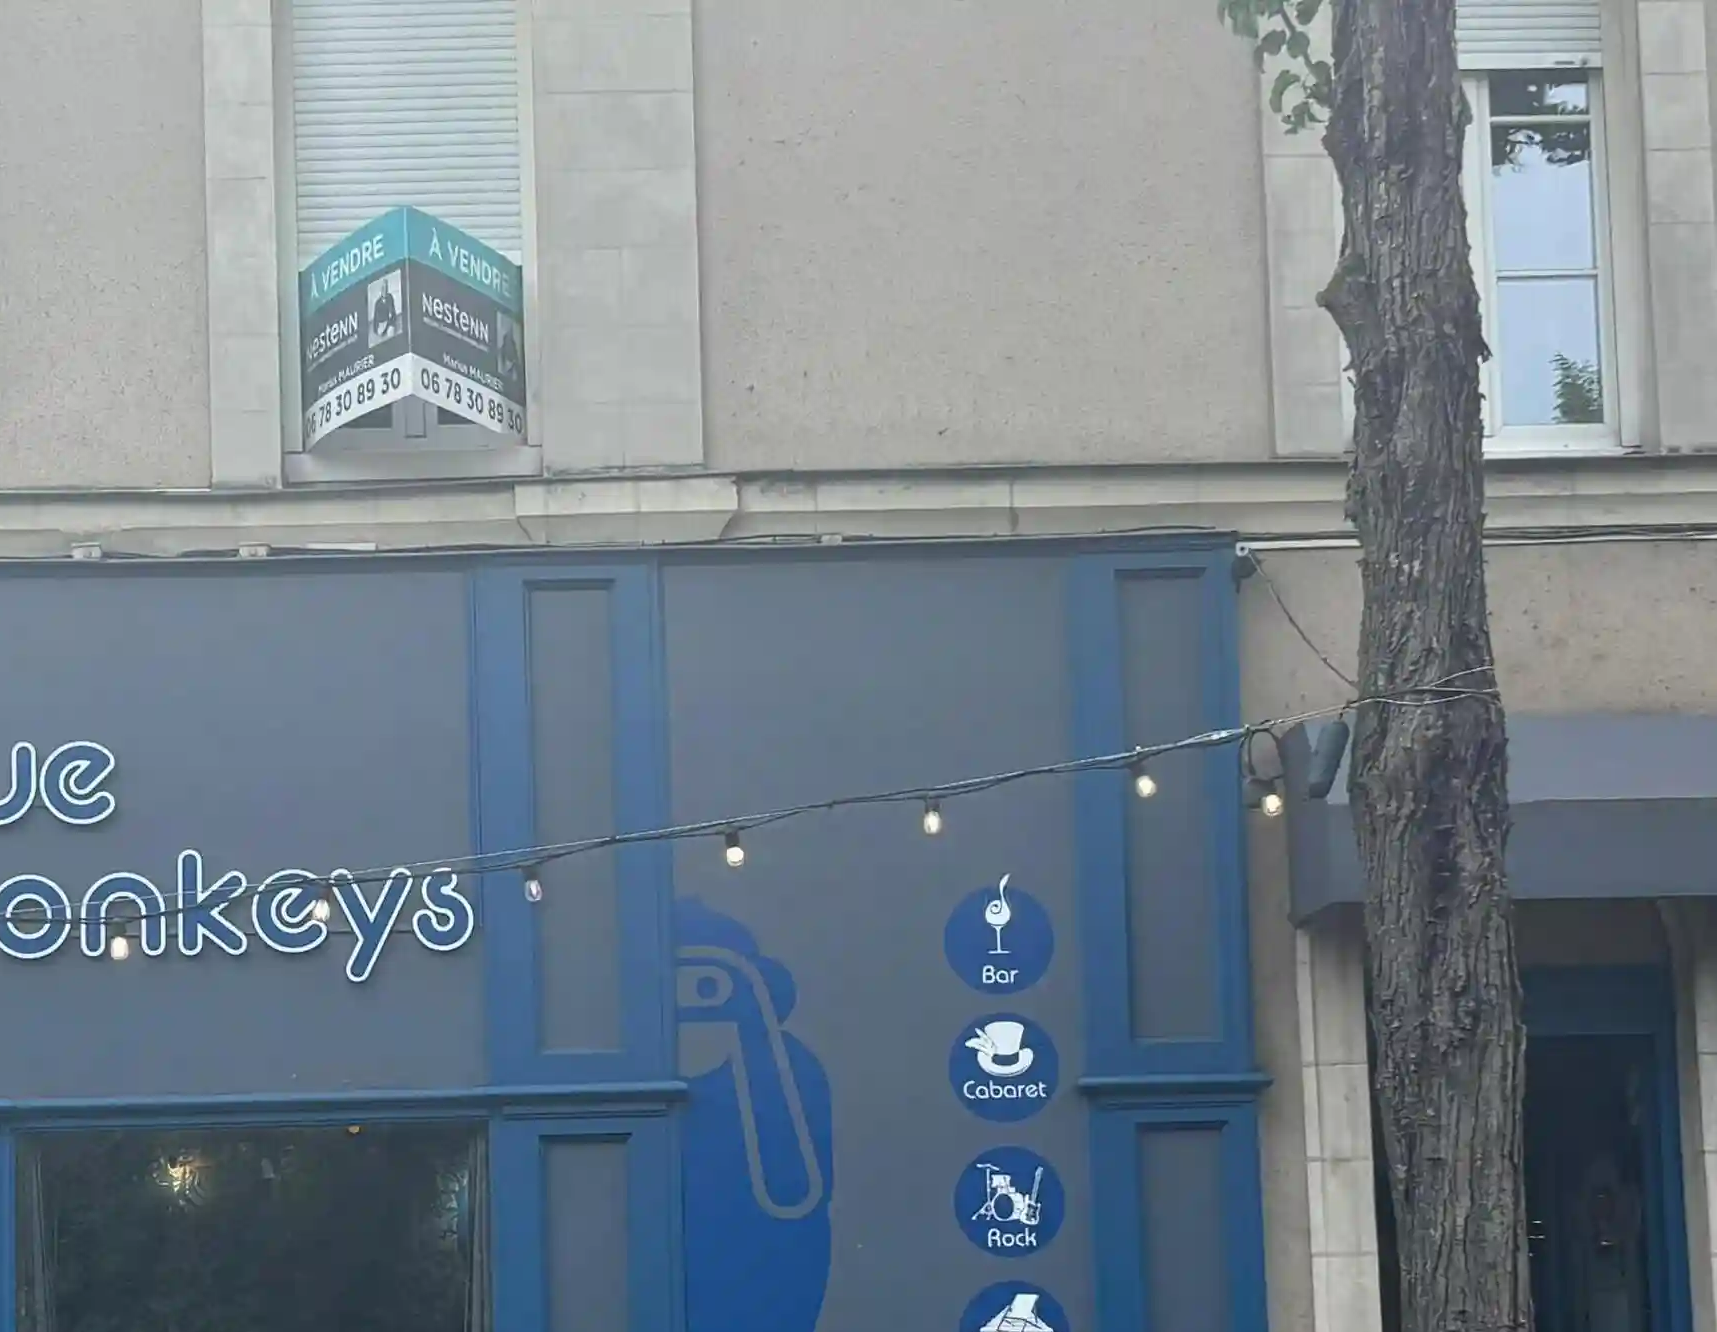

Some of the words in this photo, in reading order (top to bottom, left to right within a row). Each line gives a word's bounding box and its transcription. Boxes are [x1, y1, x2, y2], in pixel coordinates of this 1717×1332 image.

[321, 234, 385, 292] VENDRE
[429, 227, 443, 260] À
[448, 239, 513, 298] VENDRE
[319, 401, 331, 427] 78
[335, 389, 352, 416] 30
[357, 378, 375, 404] 89
[381, 367, 401, 395] 30
[421, 367, 440, 394] 06
[445, 377, 462, 404] 78
[467, 388, 483, 414] 30
[488, 398, 504, 424] 89
[507, 408, 522, 434] 30
[982, 965, 1018, 986] Bar
[963, 1080, 1047, 1100] Cabaret
[987, 1227, 1037, 1248] Rock
